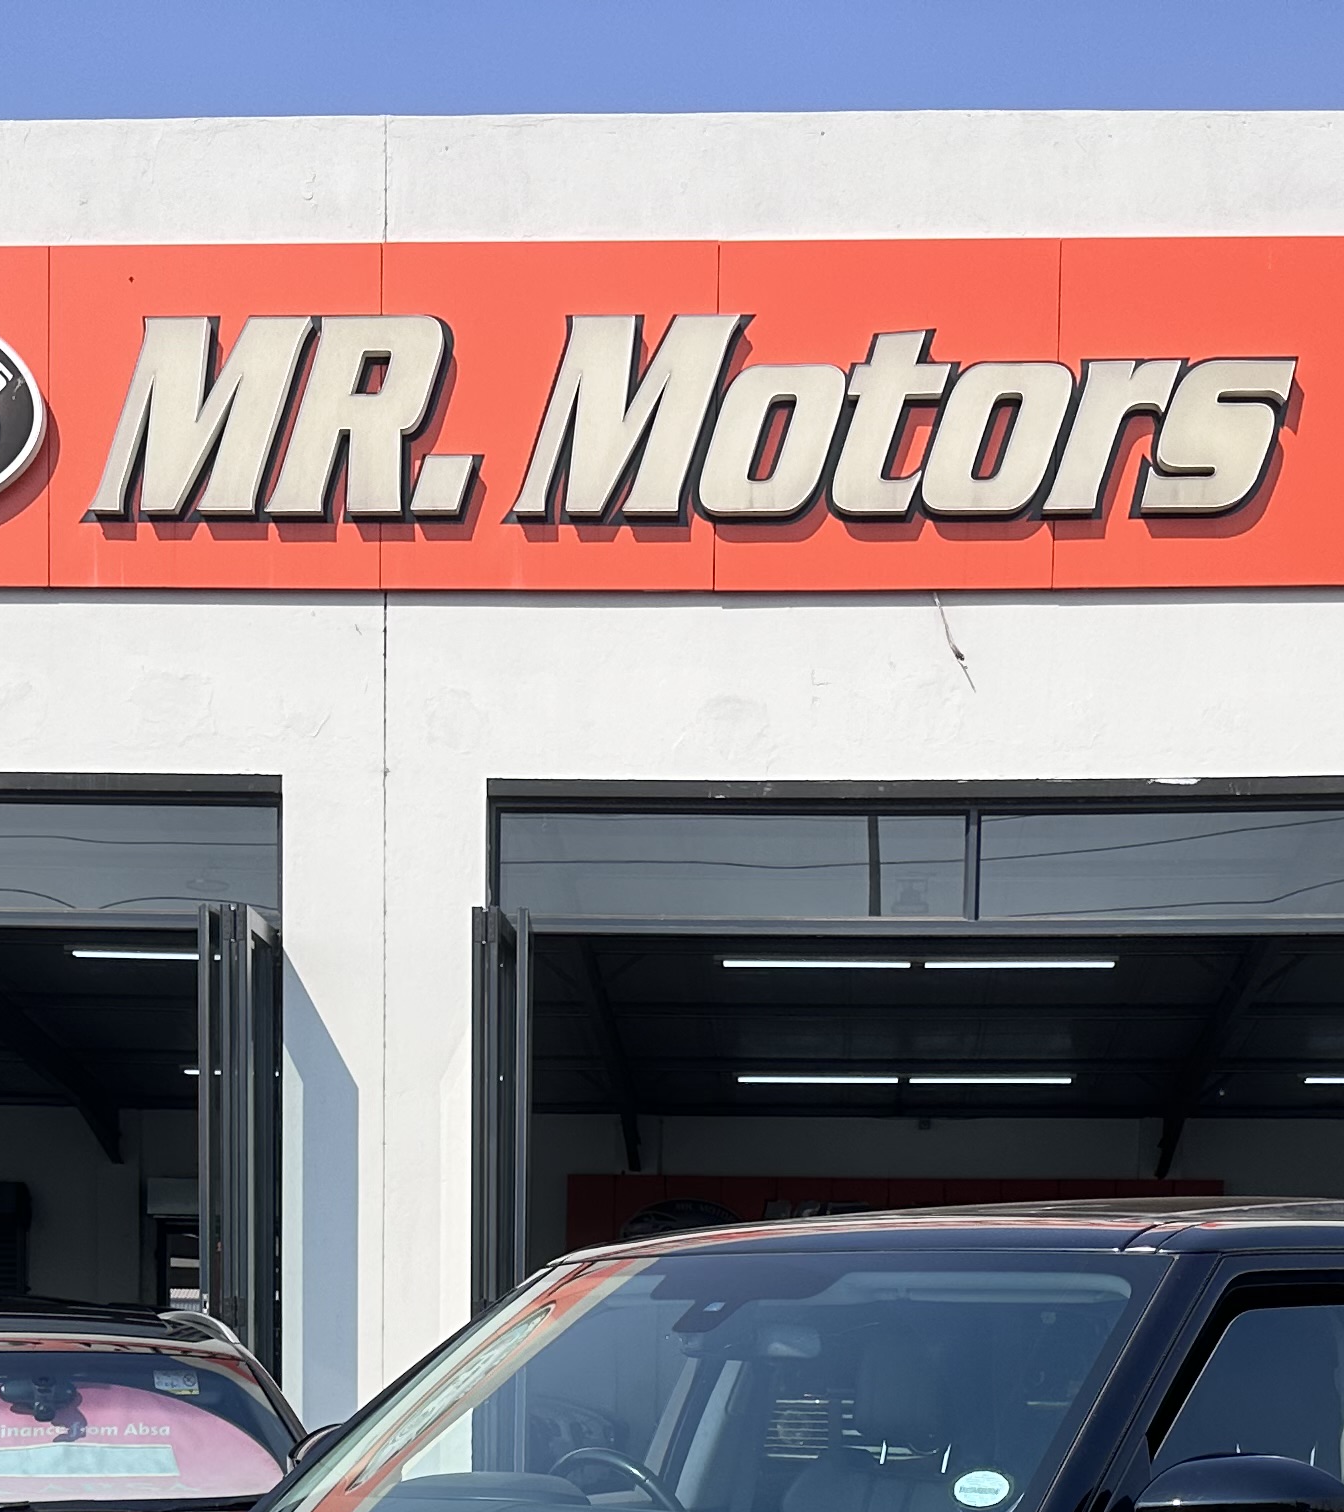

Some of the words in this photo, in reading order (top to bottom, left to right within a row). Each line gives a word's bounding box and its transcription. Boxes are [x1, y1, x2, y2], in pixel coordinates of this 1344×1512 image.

[85, 315, 478, 519] MR.
[508, 314, 1298, 518] Motors
[124, 1423, 171, 1437] Absa
